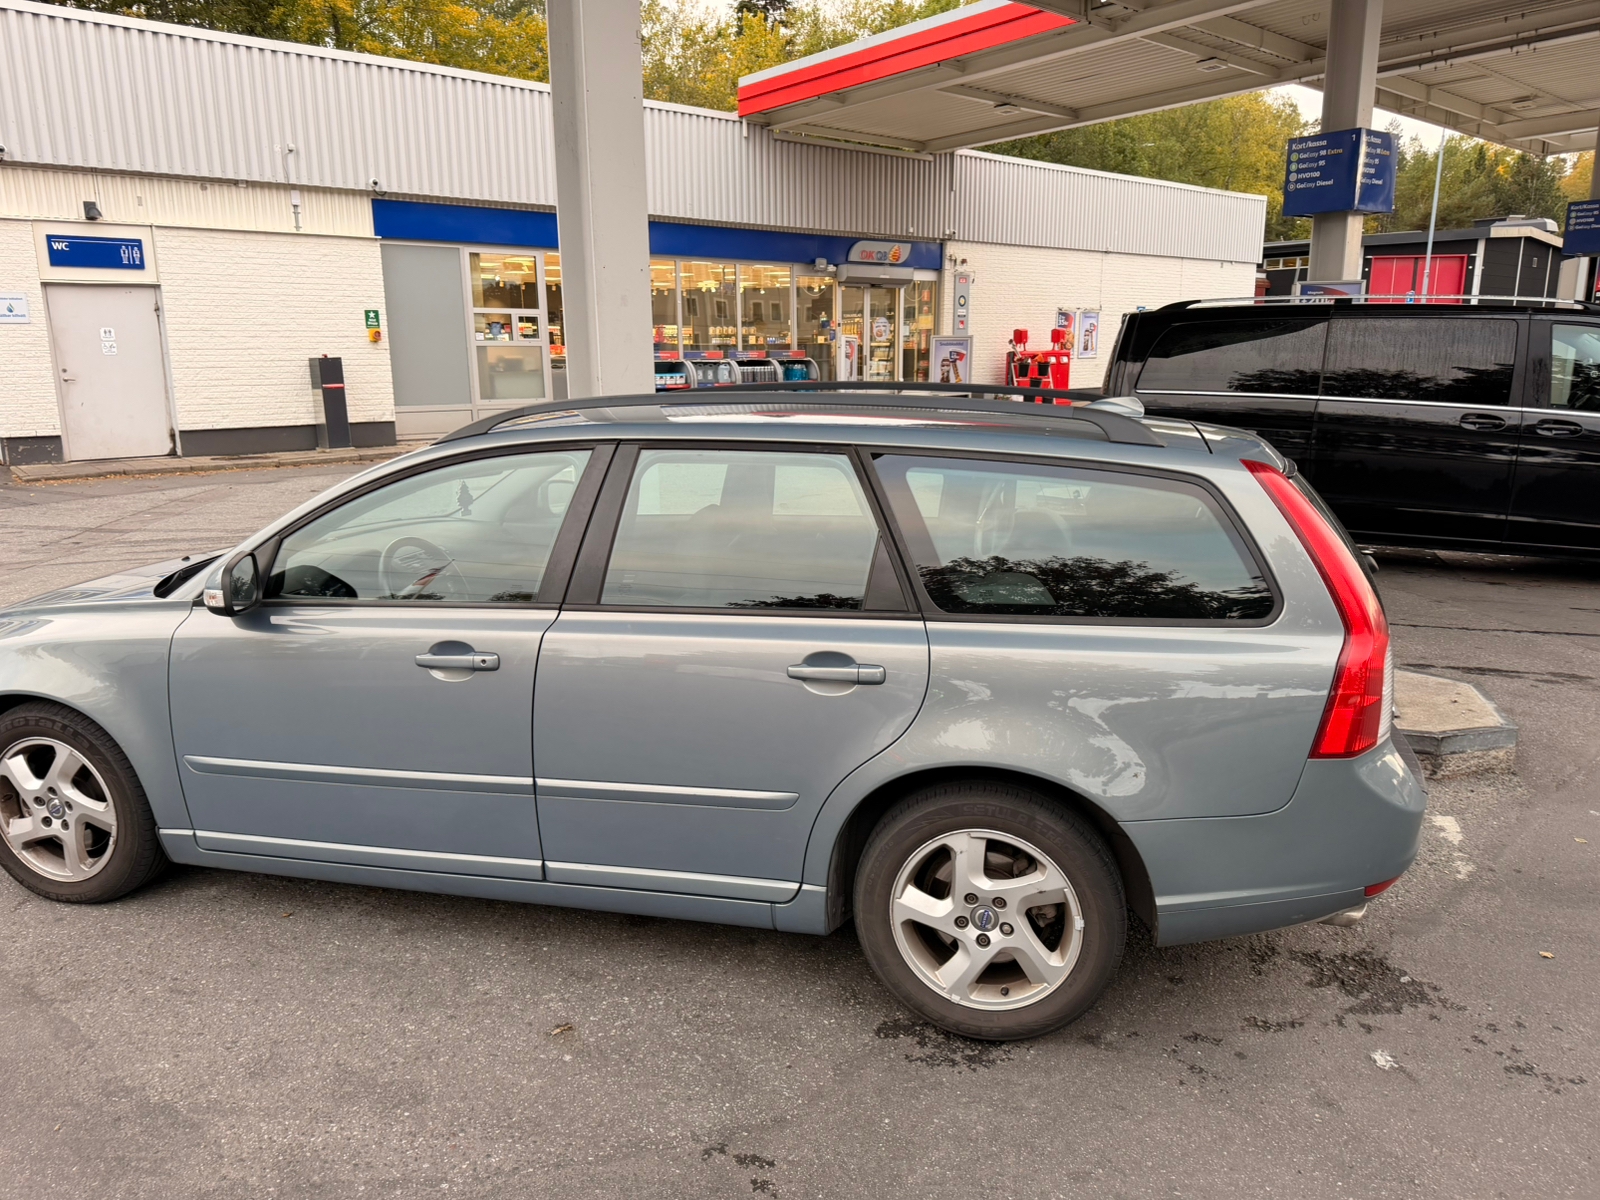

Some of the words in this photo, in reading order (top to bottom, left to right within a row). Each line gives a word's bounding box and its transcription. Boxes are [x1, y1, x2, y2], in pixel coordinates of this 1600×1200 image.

[1292, 140, 1327, 151] Kort/kassa
[1299, 151, 1319, 159] GoEasy
[1298, 171, 1320, 179] HVO100
[1316, 178, 1334, 187] Diesel
[51, 241, 70, 250] WC
[962, 804, 1028, 826] SETULA
